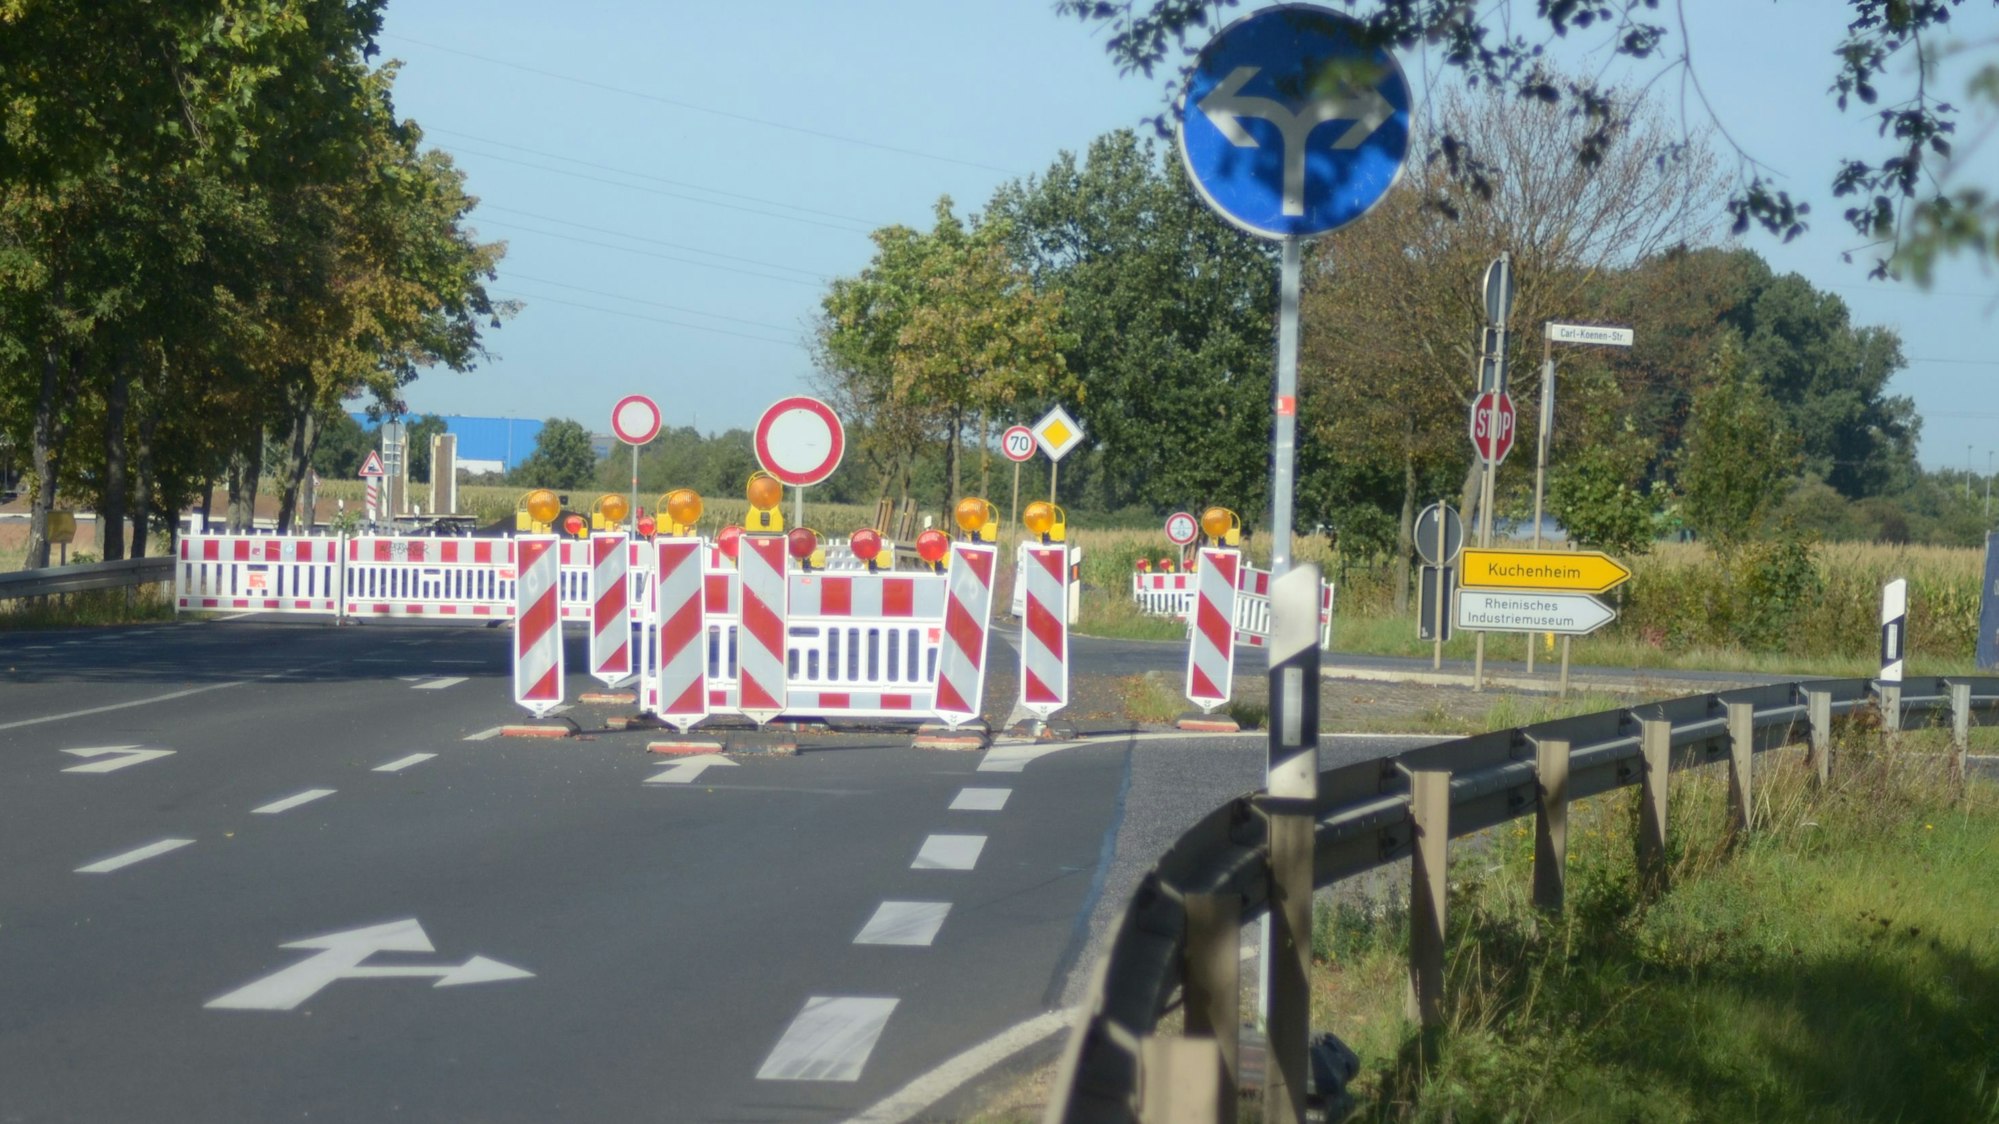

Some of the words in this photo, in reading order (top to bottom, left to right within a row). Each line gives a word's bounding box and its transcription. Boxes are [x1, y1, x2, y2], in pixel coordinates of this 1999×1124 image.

[1010, 436, 1029, 451] 70
[1488, 563, 1581, 578] Kuchenheim
[1485, 598, 1558, 611] Rheinisches
[1468, 612, 1574, 626] Industriemuseum
